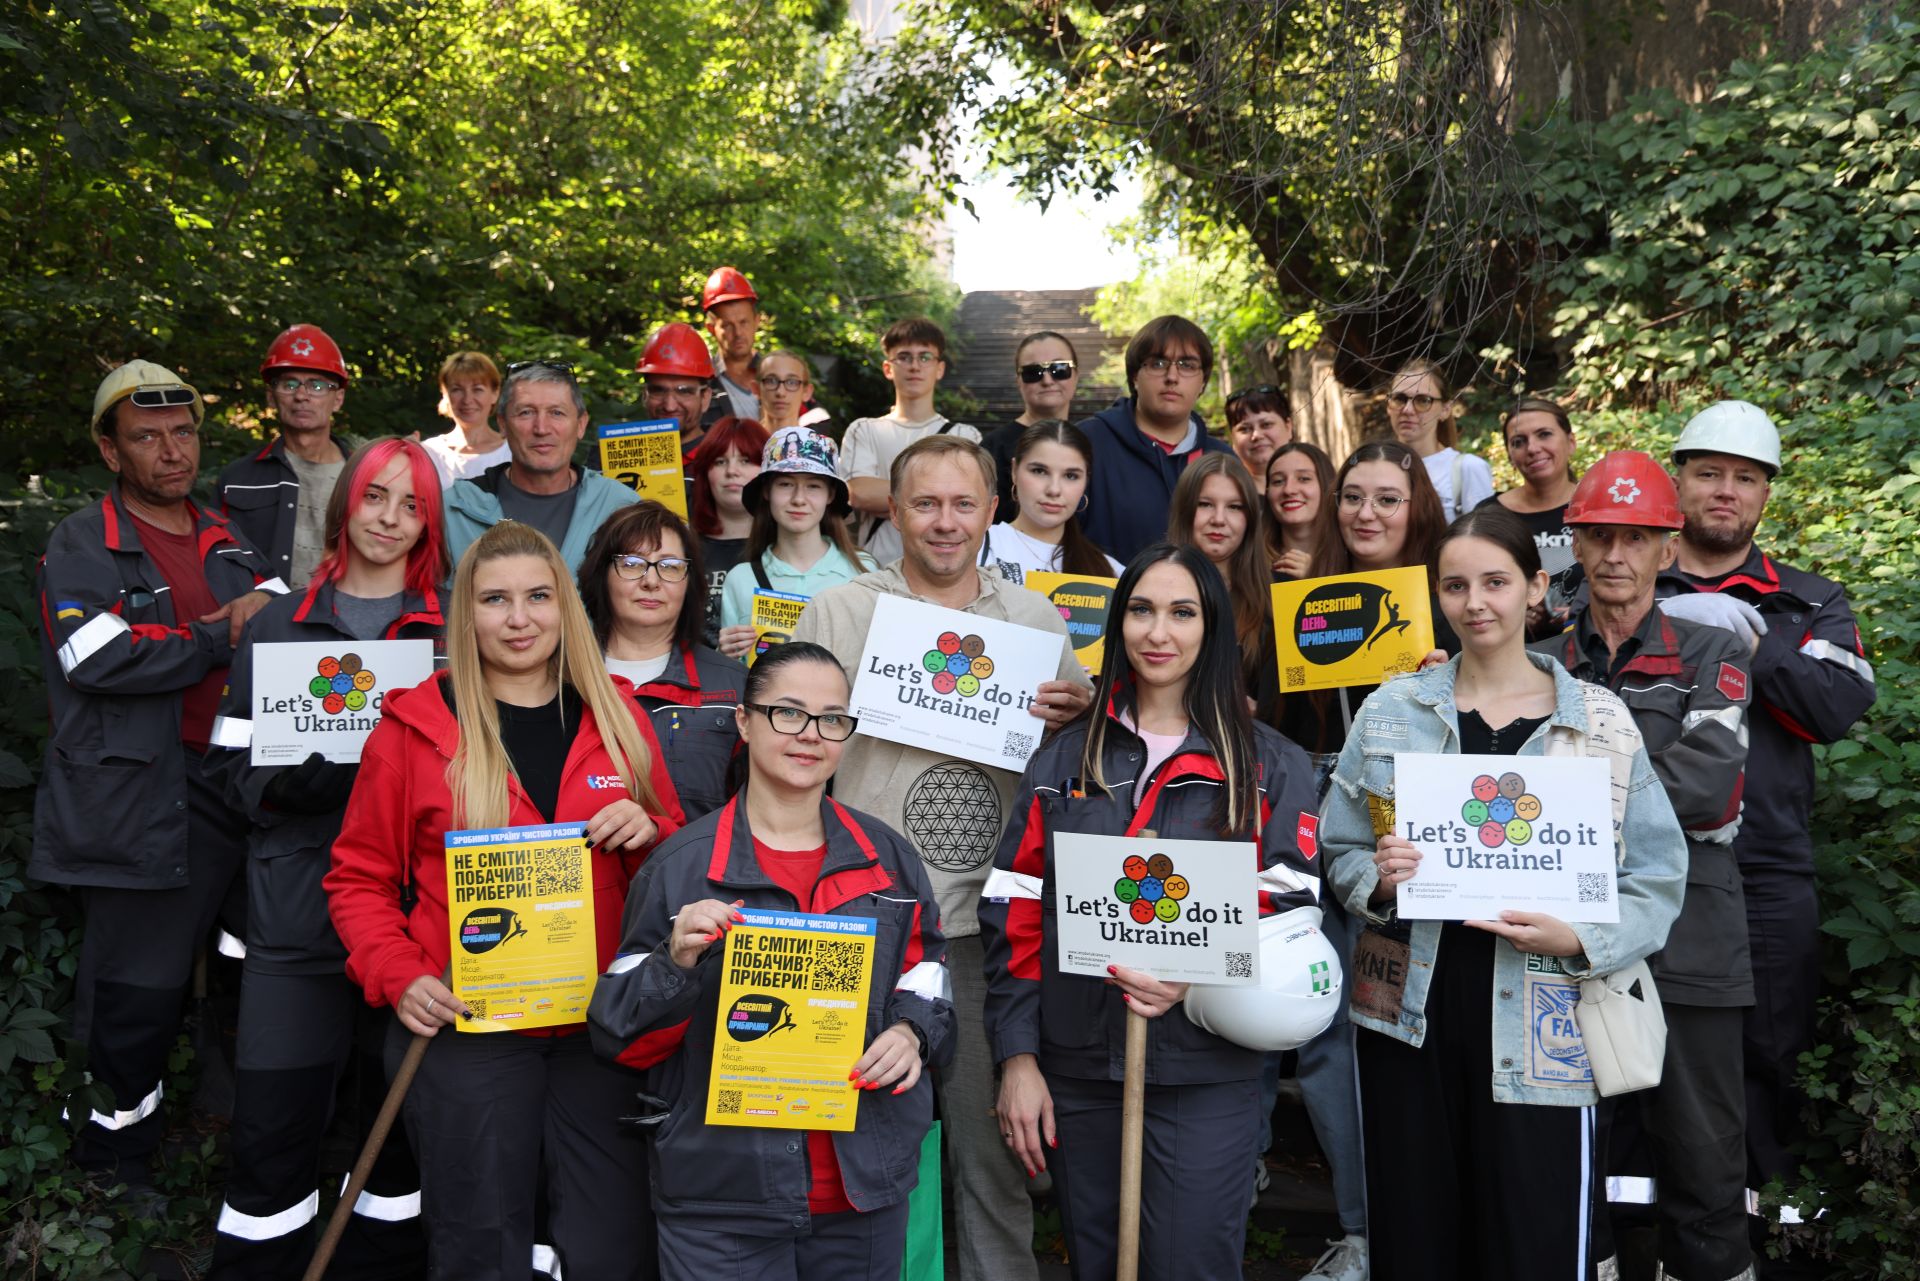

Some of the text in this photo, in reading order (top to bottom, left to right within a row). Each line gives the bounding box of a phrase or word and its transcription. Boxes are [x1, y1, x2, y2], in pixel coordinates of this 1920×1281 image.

[607, 438, 647, 450] НЕ СМІТИ!
[608, 447, 648, 460] ПОБАЧИВ?
[608, 457, 648, 470] ПРИБЕРИ!
[1054, 593, 1106, 609] ВСЕСВІТНІЙ
[1305, 593, 1362, 615] ВСЕСВІТНІЙ
[1302, 616, 1328, 631] ДЕНЬ
[1299, 627, 1364, 647] ПРИБИРАННЯ
[869, 655, 923, 684] Let’s
[984, 684, 1012, 706] do
[262, 691, 384, 714] Let’s d
[897, 685, 1000, 726] Ukraine!
[453, 828, 580, 845] ЗРОБИМО УКРАЇНУ ЧИСТОЮ РАЗОМ!
[1406, 821, 1597, 846] Let’s do it
[454, 850, 531, 869] НЕ СМІТИ!
[1445, 847, 1563, 871] Ukraine!
[455, 866, 534, 885] ПОБАЧИВ?
[456, 883, 532, 902] ПРИБЕРИ!
[1066, 894, 1242, 924] Let’s do it
[466, 914, 501, 925] ВСЕСВІТНІЙ
[743, 914, 867, 932] РОБИМО УКРАЇНУ ЧИСТОЮ РАЗОМ!
[462, 932, 501, 944] ПРИБИРАННЯ
[464, 926, 480, 934] ДЕНЬ
[1100, 921, 1208, 948] Ukraine!
[734, 934, 813, 954] НЕ СМІТИ!
[732, 952, 813, 972] ПОБАЧИВ?
[730, 969, 808, 990] ПРИБЕРИ!
[732, 1012, 749, 1020] ДЕНЬ
[736, 1002, 772, 1013] ВСЕСВІТНІЙ
[729, 1020, 770, 1032] ПРИБИРАННЯ
[723, 1044, 742, 1052] Дата:
[722, 1054, 744, 1062] Місце:
[721, 1062, 768, 1073] Координатор:
